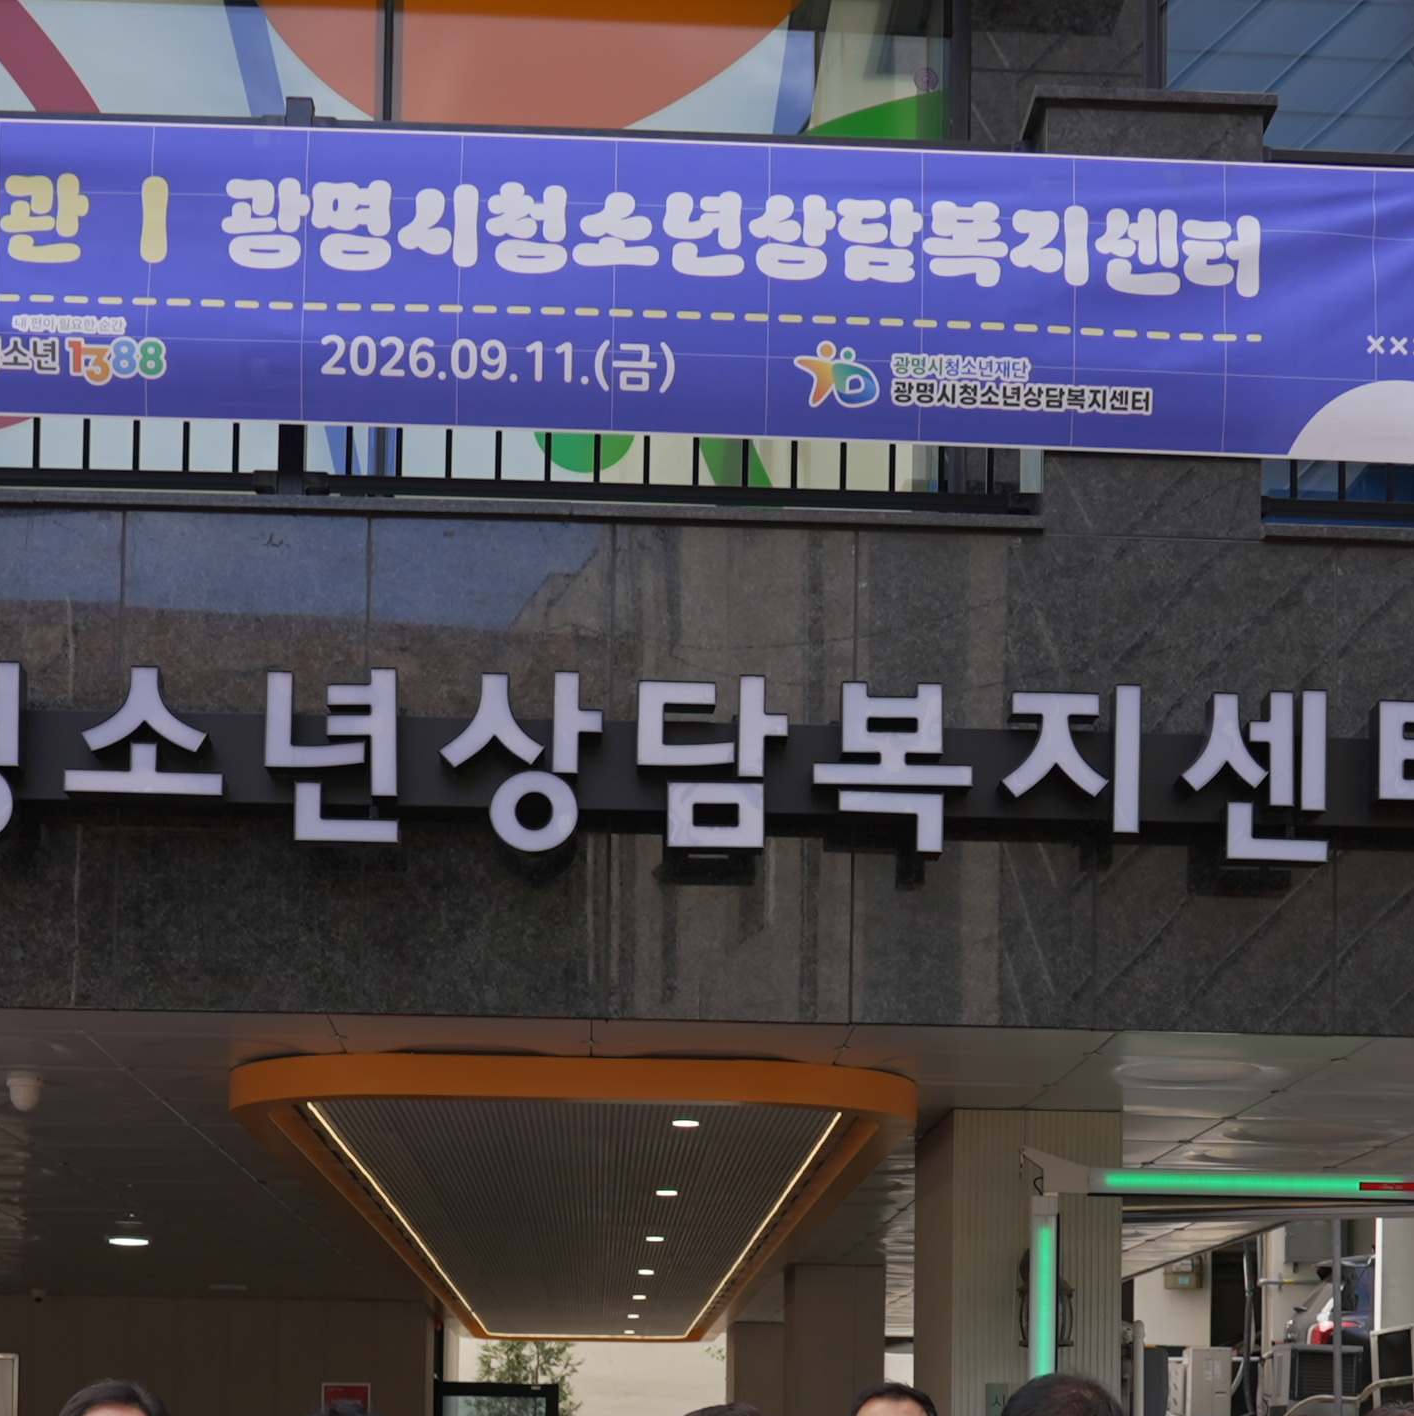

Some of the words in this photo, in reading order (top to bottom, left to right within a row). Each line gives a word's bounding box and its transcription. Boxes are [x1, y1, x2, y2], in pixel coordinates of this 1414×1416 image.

[220, 177, 1262, 297] 광명시청소년상담복지센터
[14, 317, 27, 332] 내
[30, 317, 55, 332] 편이
[59, 318, 95, 333] 필요한
[99, 318, 125, 334] 순간
[67, 338, 164, 383] 1388
[320, 332, 676, 395] 2026.09.11.(금)
[892, 355, 1029, 379] 광명시청소년재단
[892, 381, 1151, 413] 광명시청소년상담복지센터
